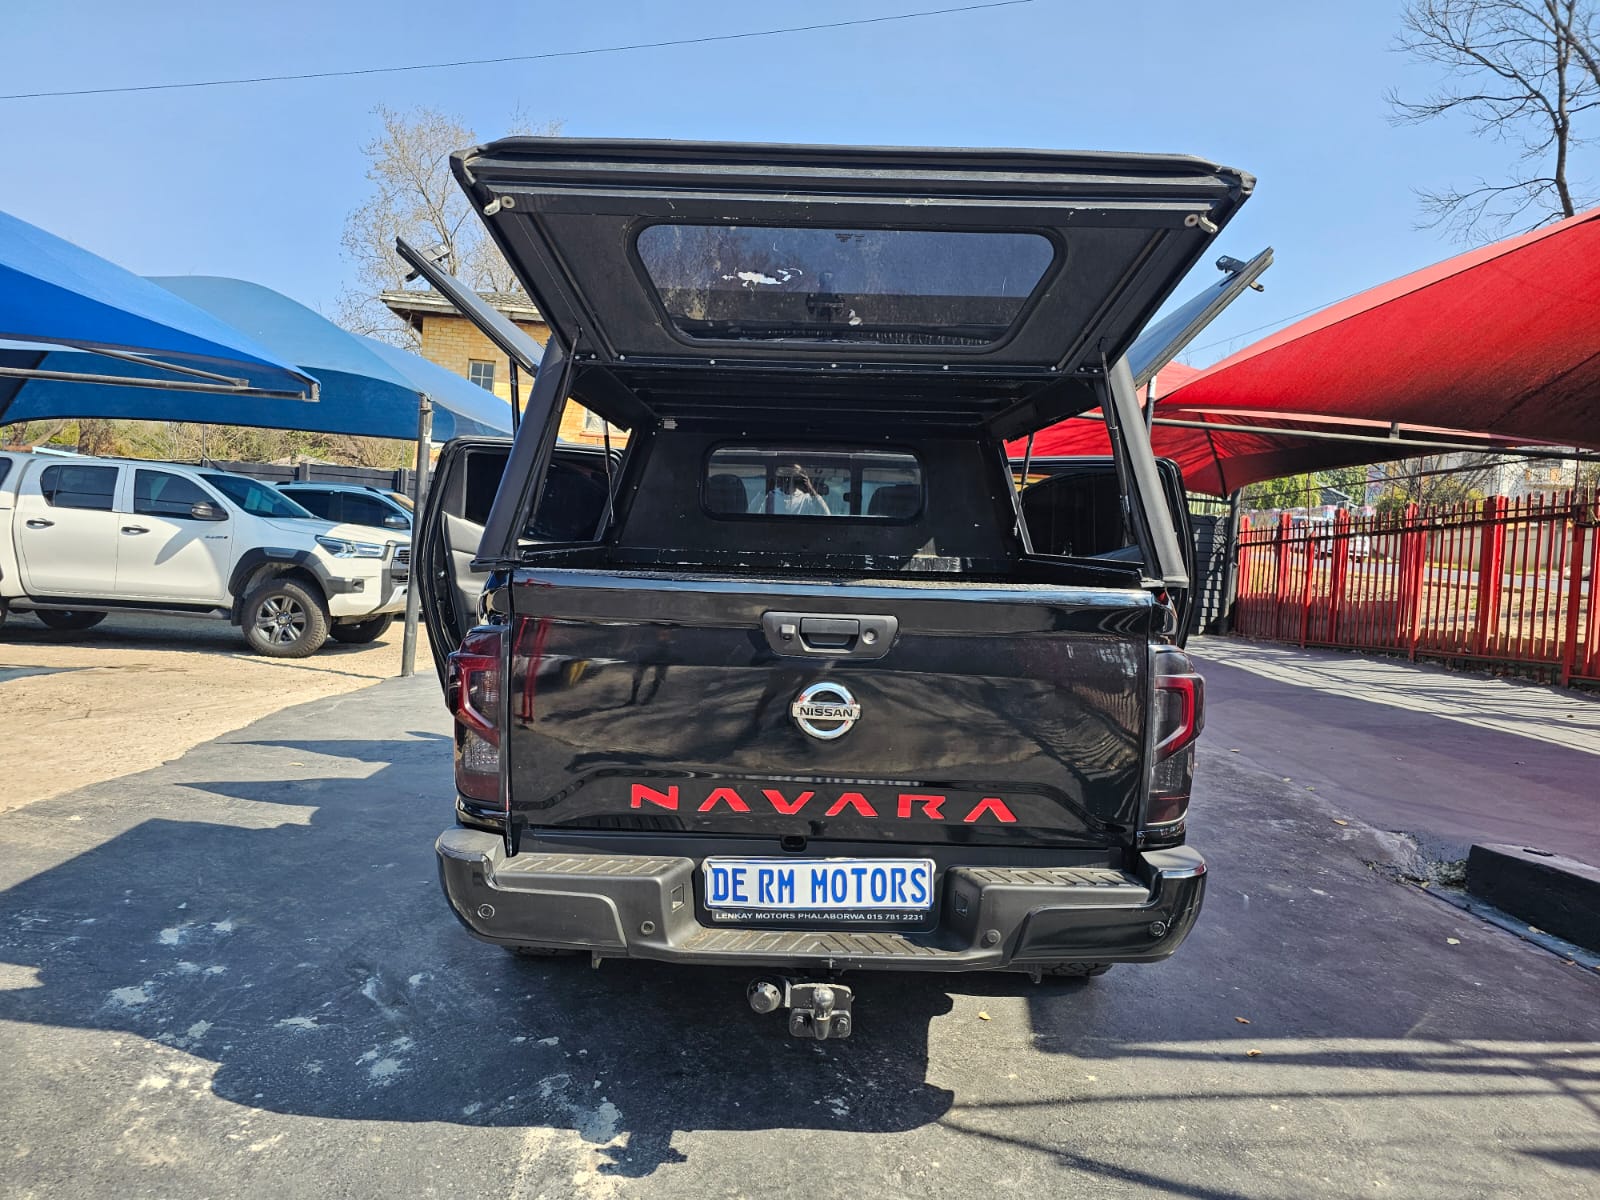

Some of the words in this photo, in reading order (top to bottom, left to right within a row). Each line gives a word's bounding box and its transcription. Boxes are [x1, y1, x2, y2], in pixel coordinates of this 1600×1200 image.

[799, 707, 853, 717] NISSAN
[631, 783, 1017, 823] NAVARA
[712, 867, 748, 902] DE
[758, 868, 795, 904] RM
[811, 867, 927, 904] MOTORS
[798, 912, 865, 920] PHALABORWA
